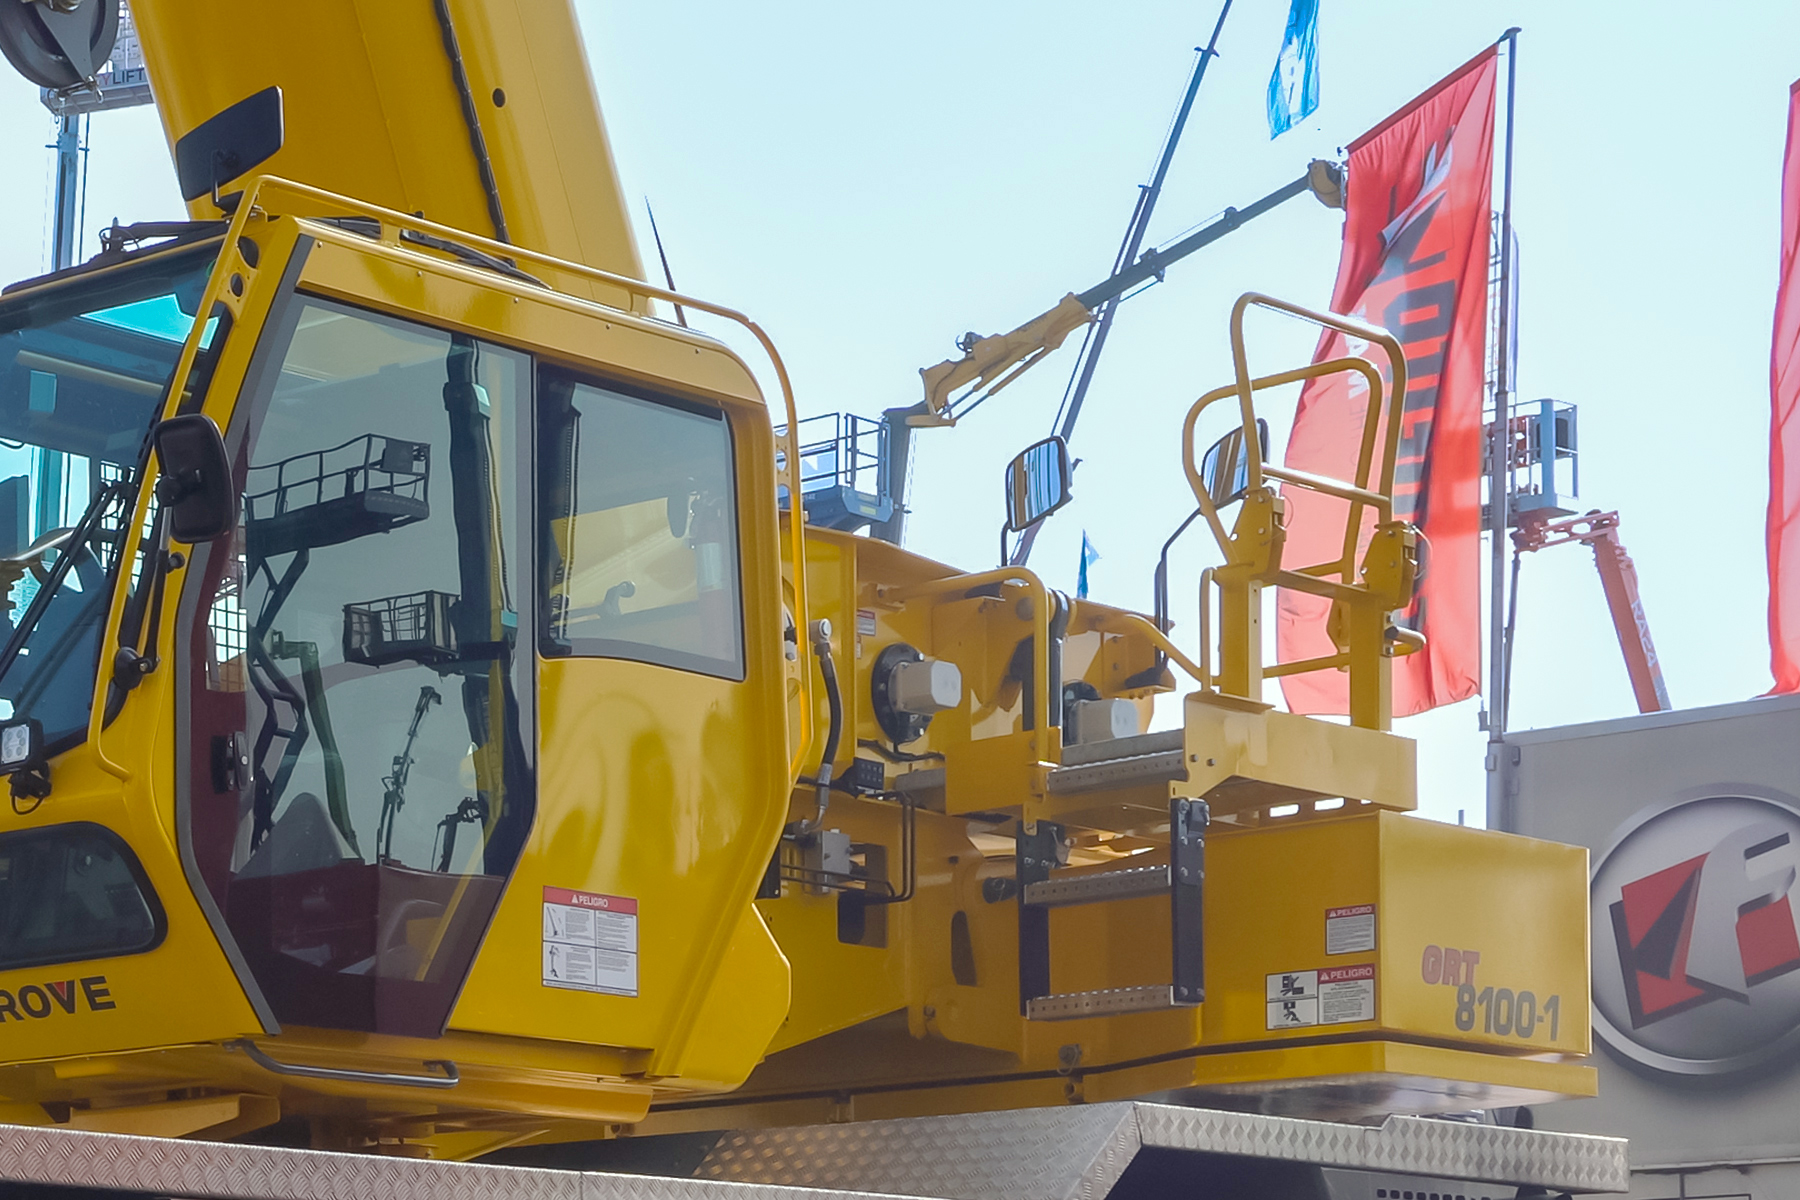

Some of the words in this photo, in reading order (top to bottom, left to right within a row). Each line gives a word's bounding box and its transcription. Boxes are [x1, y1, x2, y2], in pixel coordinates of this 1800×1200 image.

[1337, 906, 1372, 916] PELIGRO
[1330, 967, 1373, 979] PELIGRO
[1455, 983, 1560, 1042] 8100-1
